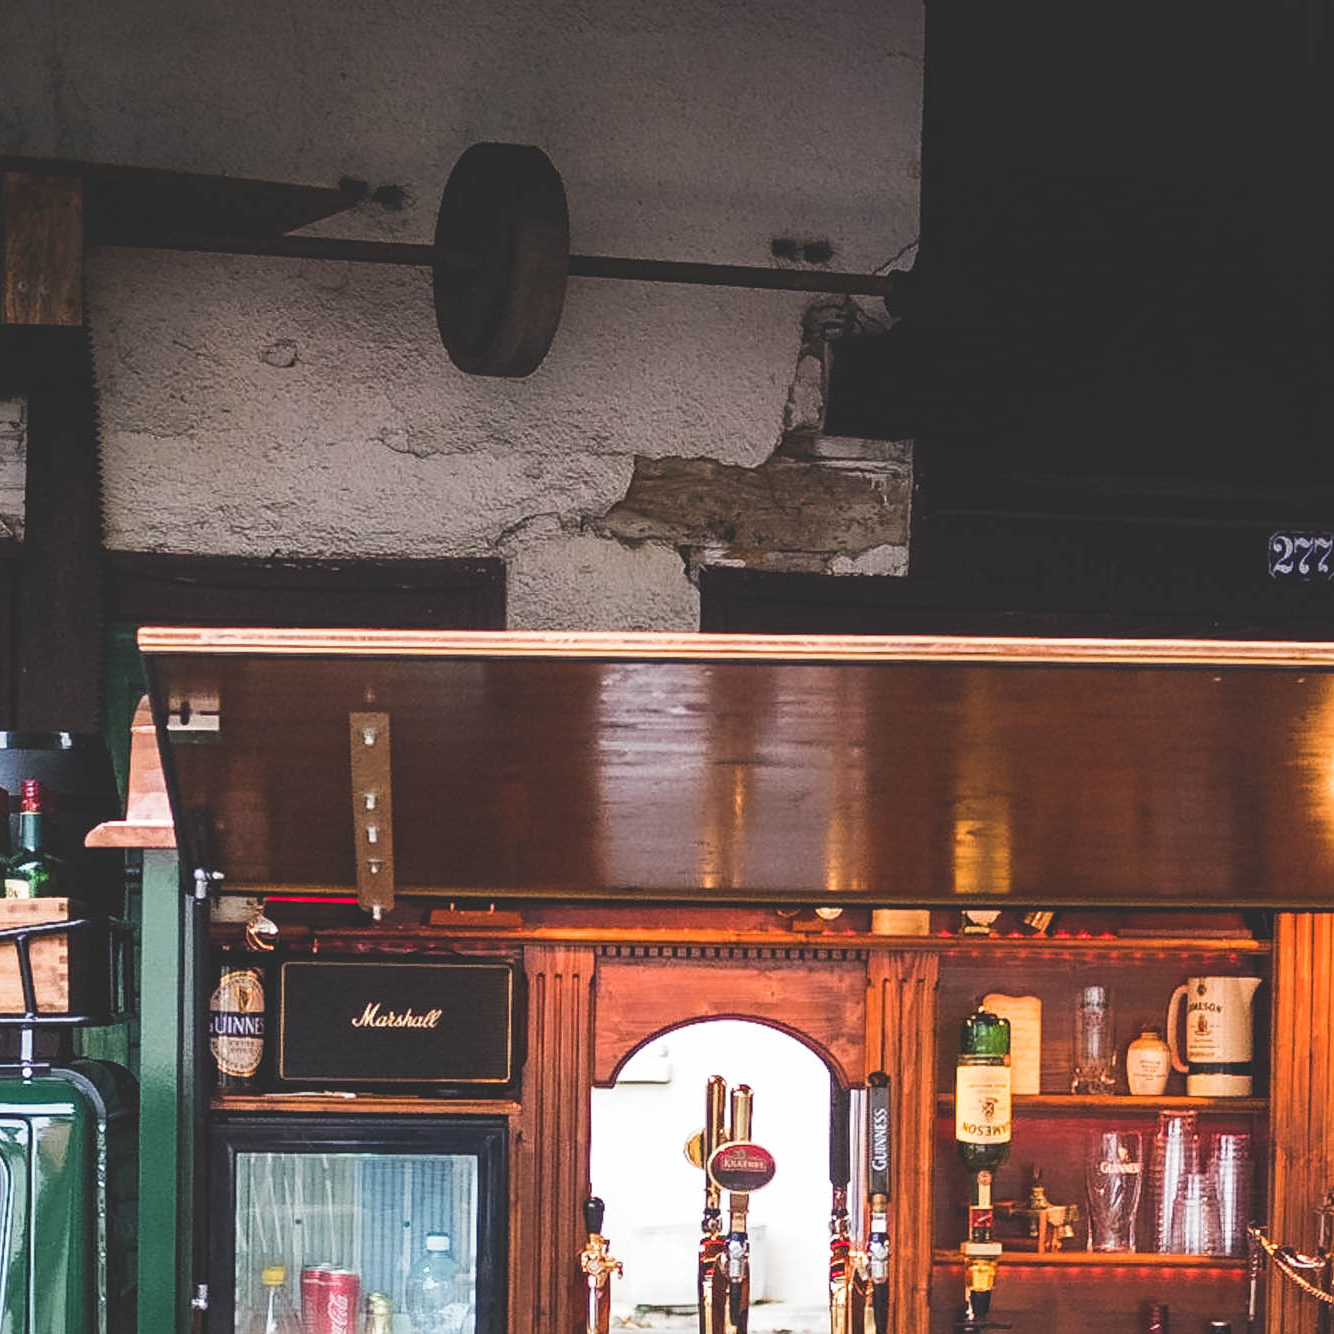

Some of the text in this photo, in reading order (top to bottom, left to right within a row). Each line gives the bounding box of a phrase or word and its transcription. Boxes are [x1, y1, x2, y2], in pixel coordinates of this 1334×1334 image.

[1273, 535, 1334, 575] 277
[351, 1002, 443, 1029] Marshall
[871, 1107, 888, 1171] GUINNESS
